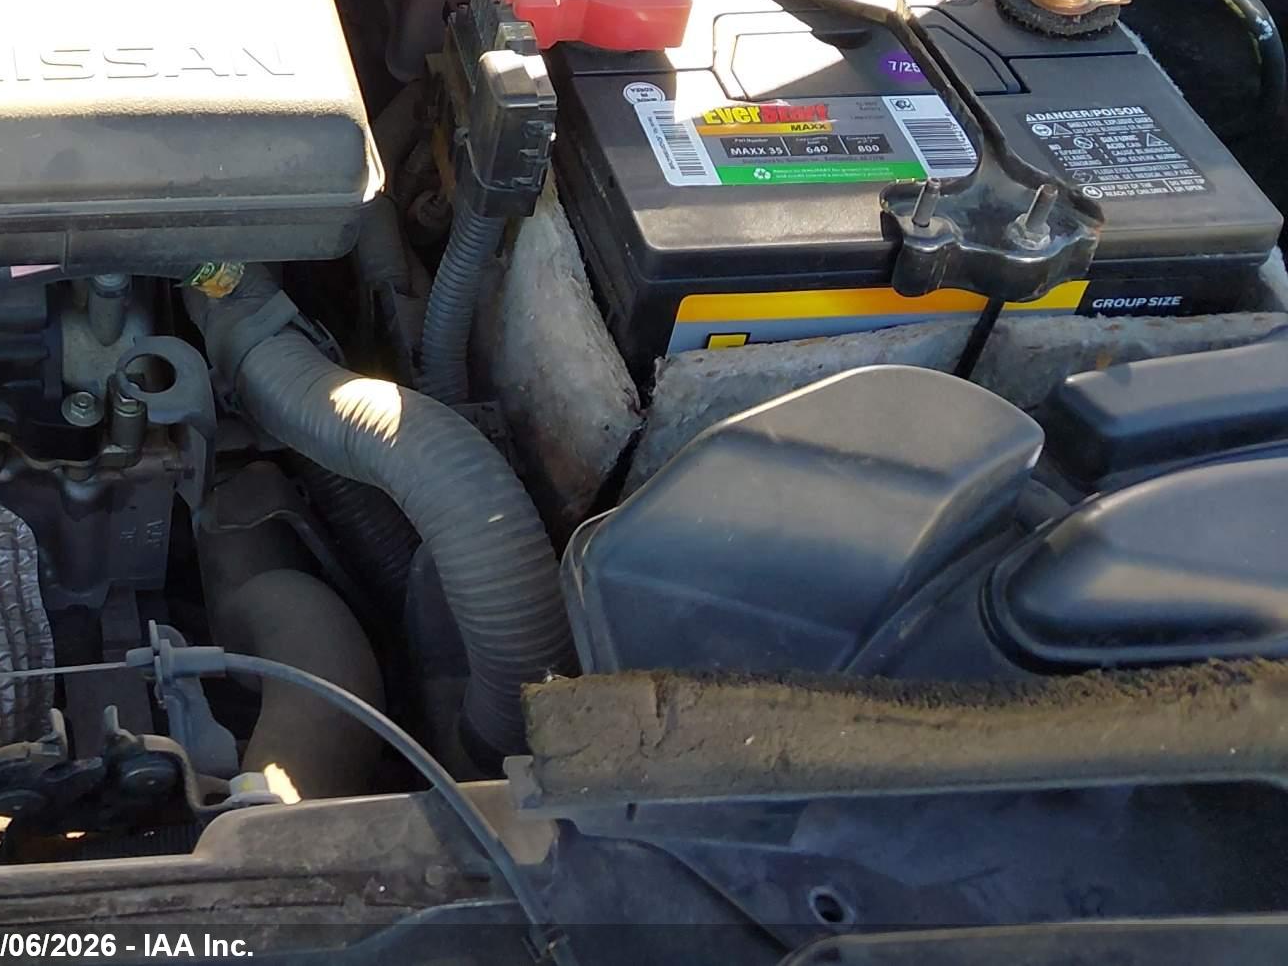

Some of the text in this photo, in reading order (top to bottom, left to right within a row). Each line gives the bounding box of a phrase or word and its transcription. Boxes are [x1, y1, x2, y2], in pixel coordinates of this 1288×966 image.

[1035, 106, 1144, 122] DANGER/POISON
[790, 122, 827, 131] MAXX
[730, 146, 783, 155] MAXX 35
[806, 145, 829, 154] 640
[857, 144, 880, 153] 800
[1092, 296, 1183, 309] GROUP SIZE
